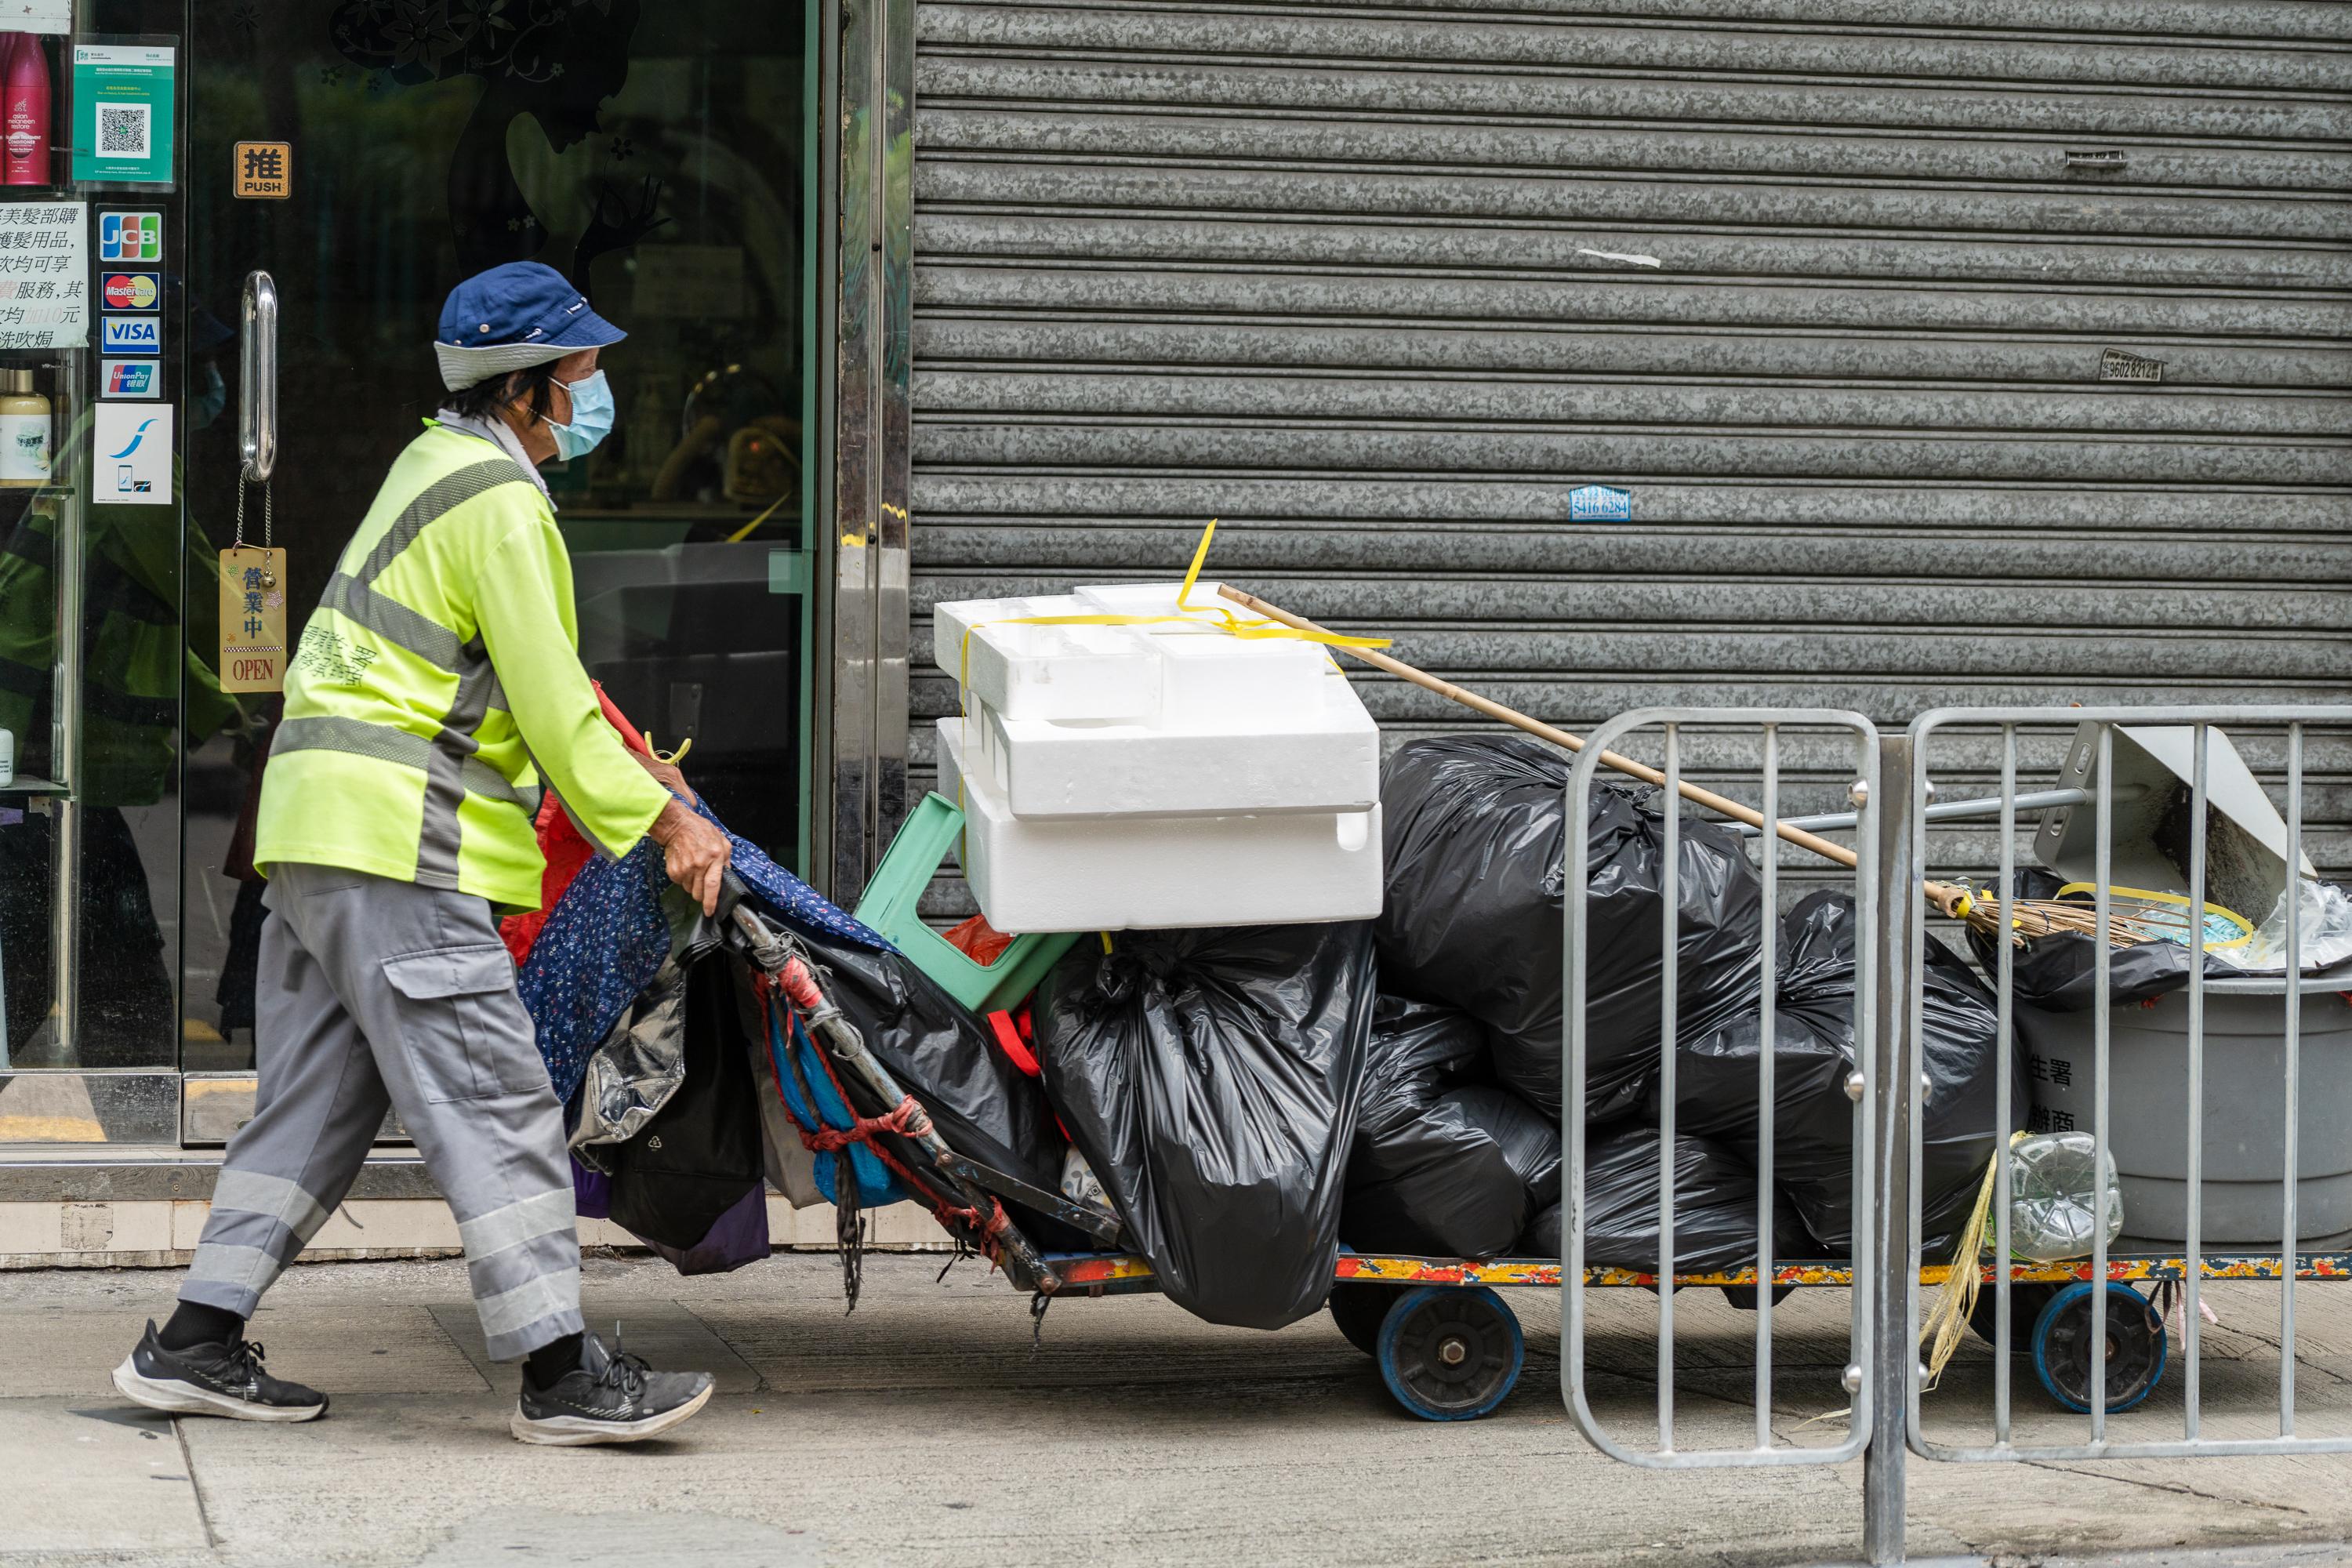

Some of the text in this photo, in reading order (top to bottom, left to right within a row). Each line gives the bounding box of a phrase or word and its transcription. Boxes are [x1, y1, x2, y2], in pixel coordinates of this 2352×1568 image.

[245, 149, 282, 179] 推
[245, 183, 281, 192] PUSH
[0, 208, 79, 226] 美髮部購
[103, 230, 156, 245] JCB
[106, 285, 154, 297] MasterCard
[109, 323, 155, 340] VISA
[113, 372, 149, 383] UnionPay
[2110, 361, 2130, 378] 9602
[2130, 362, 2151, 378] 8212
[1574, 501, 1627, 514] 5416 6284
[242, 567, 263, 639] 營業中
[233, 659, 274, 681] OPEN
[2030, 1054, 2072, 1087] 生署
